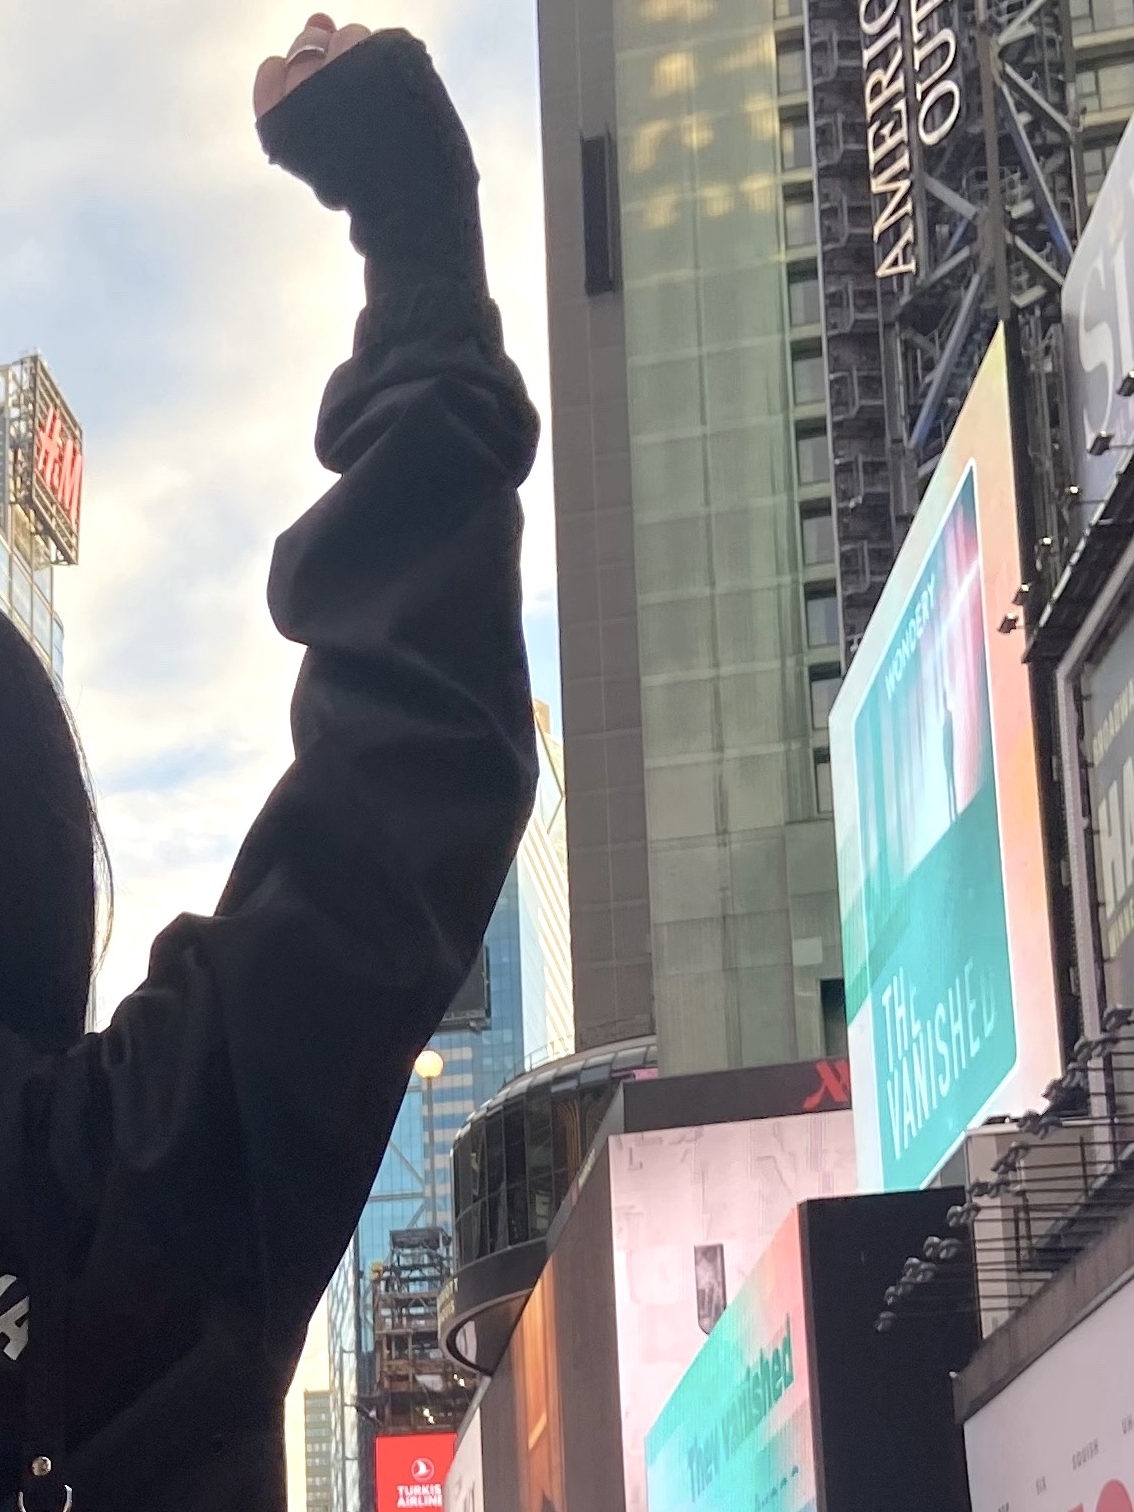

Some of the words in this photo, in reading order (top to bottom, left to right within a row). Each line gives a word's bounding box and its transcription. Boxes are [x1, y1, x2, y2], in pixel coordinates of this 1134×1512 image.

[36, 406, 83, 525] H&M
[882, 966, 922, 1073] THE
[887, 957, 995, 1160] VANISHED
[397, 1484, 442, 1496] TURKIS
